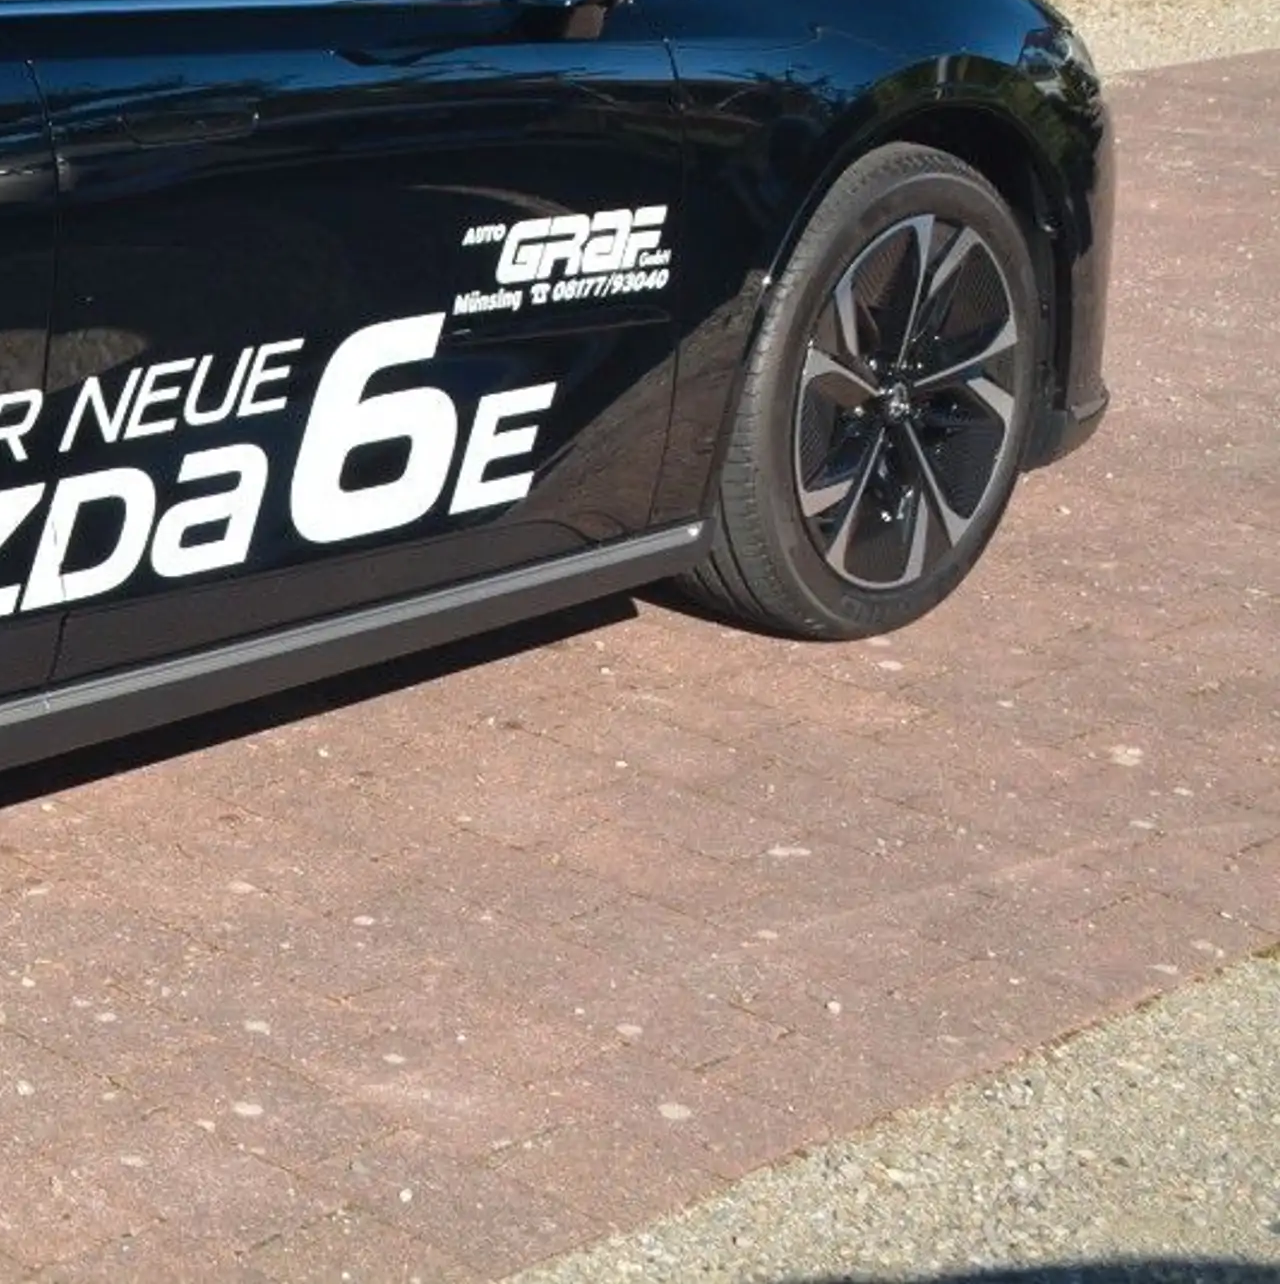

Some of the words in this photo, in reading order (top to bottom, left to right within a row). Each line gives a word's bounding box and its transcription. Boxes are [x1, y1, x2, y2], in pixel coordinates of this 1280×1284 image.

[462, 224, 506, 246] AUTO
[639, 249, 672, 268] GmbH
[453, 288, 523, 316] Münsing
[552, 269, 670, 302] 08177/93040
[58, 338, 305, 453] NEUE
